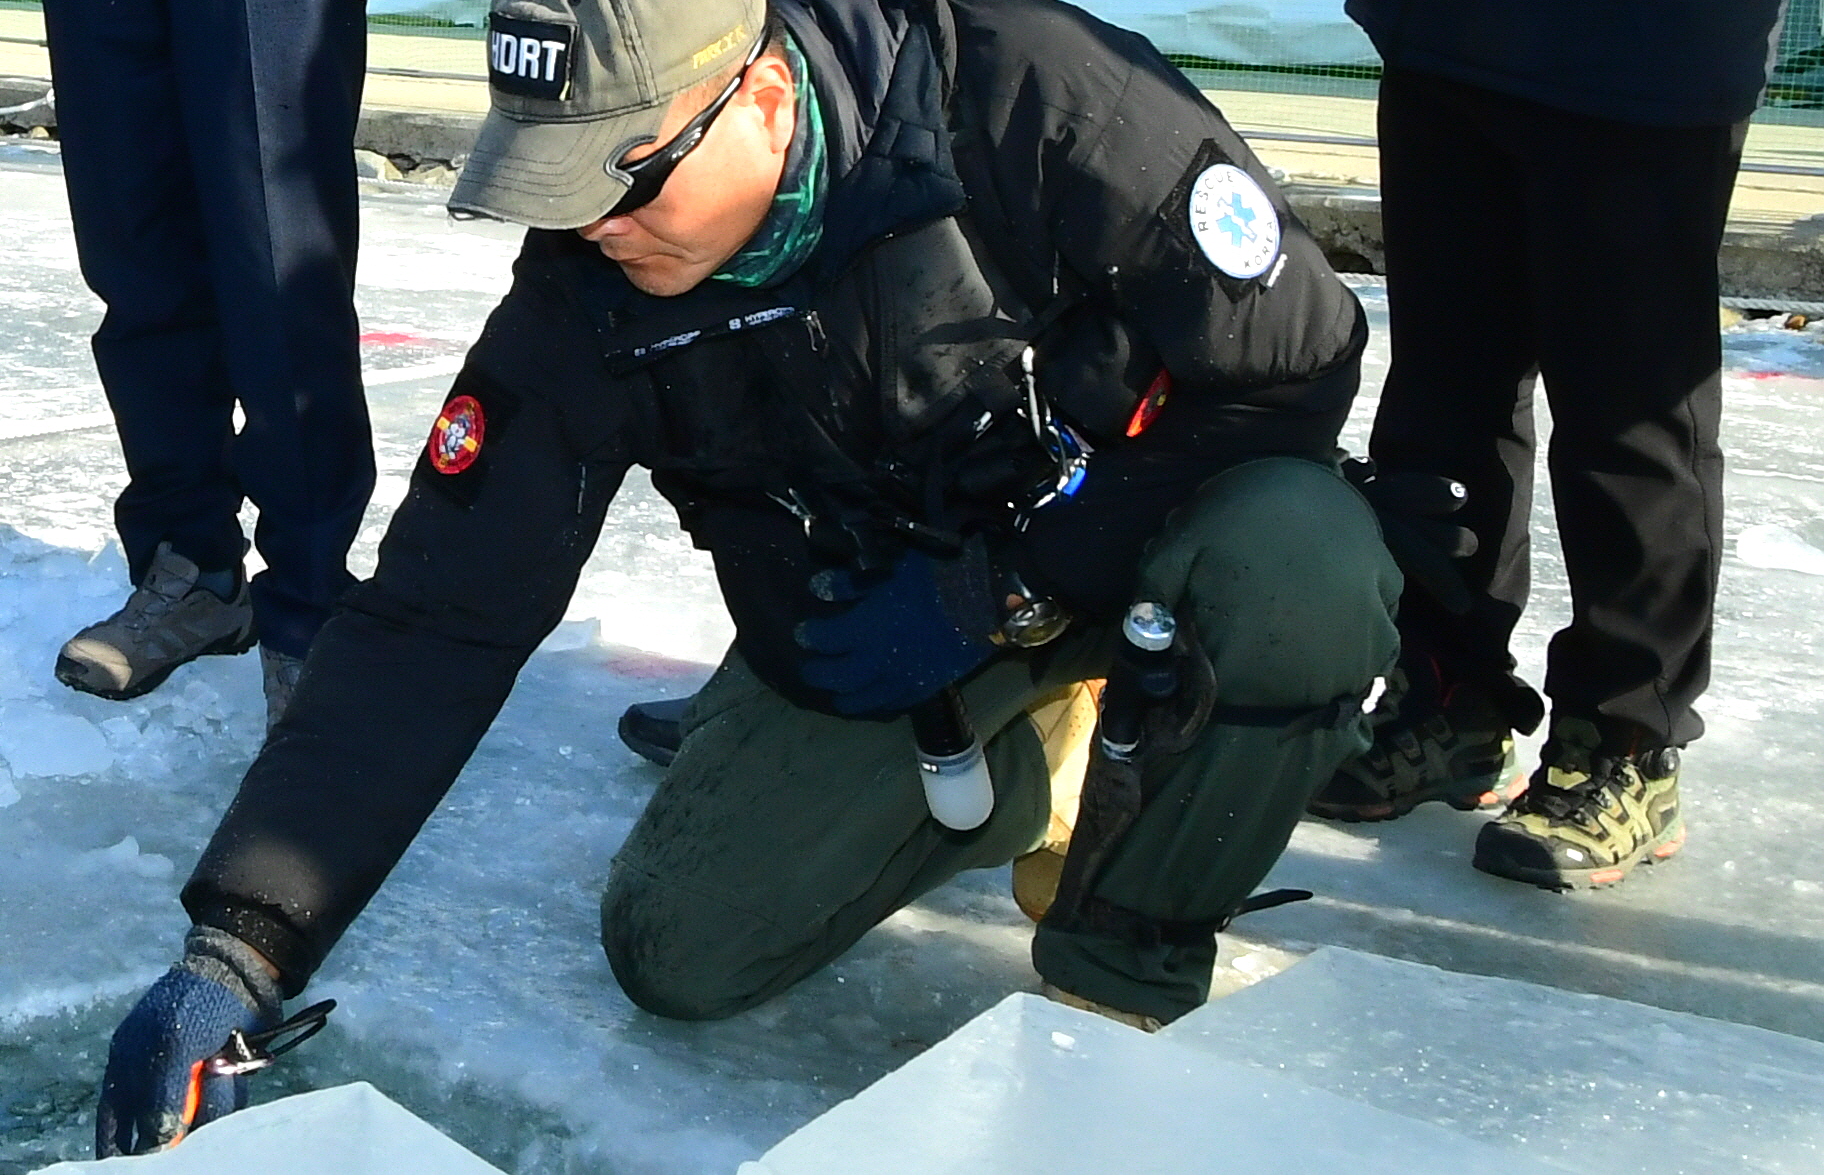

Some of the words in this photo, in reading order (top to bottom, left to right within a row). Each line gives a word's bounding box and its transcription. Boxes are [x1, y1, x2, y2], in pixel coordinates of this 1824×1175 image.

[492, 30, 566, 82] HDRT
[1195, 170, 1235, 233] RESCUE
[1243, 220, 1274, 269] KOREA
